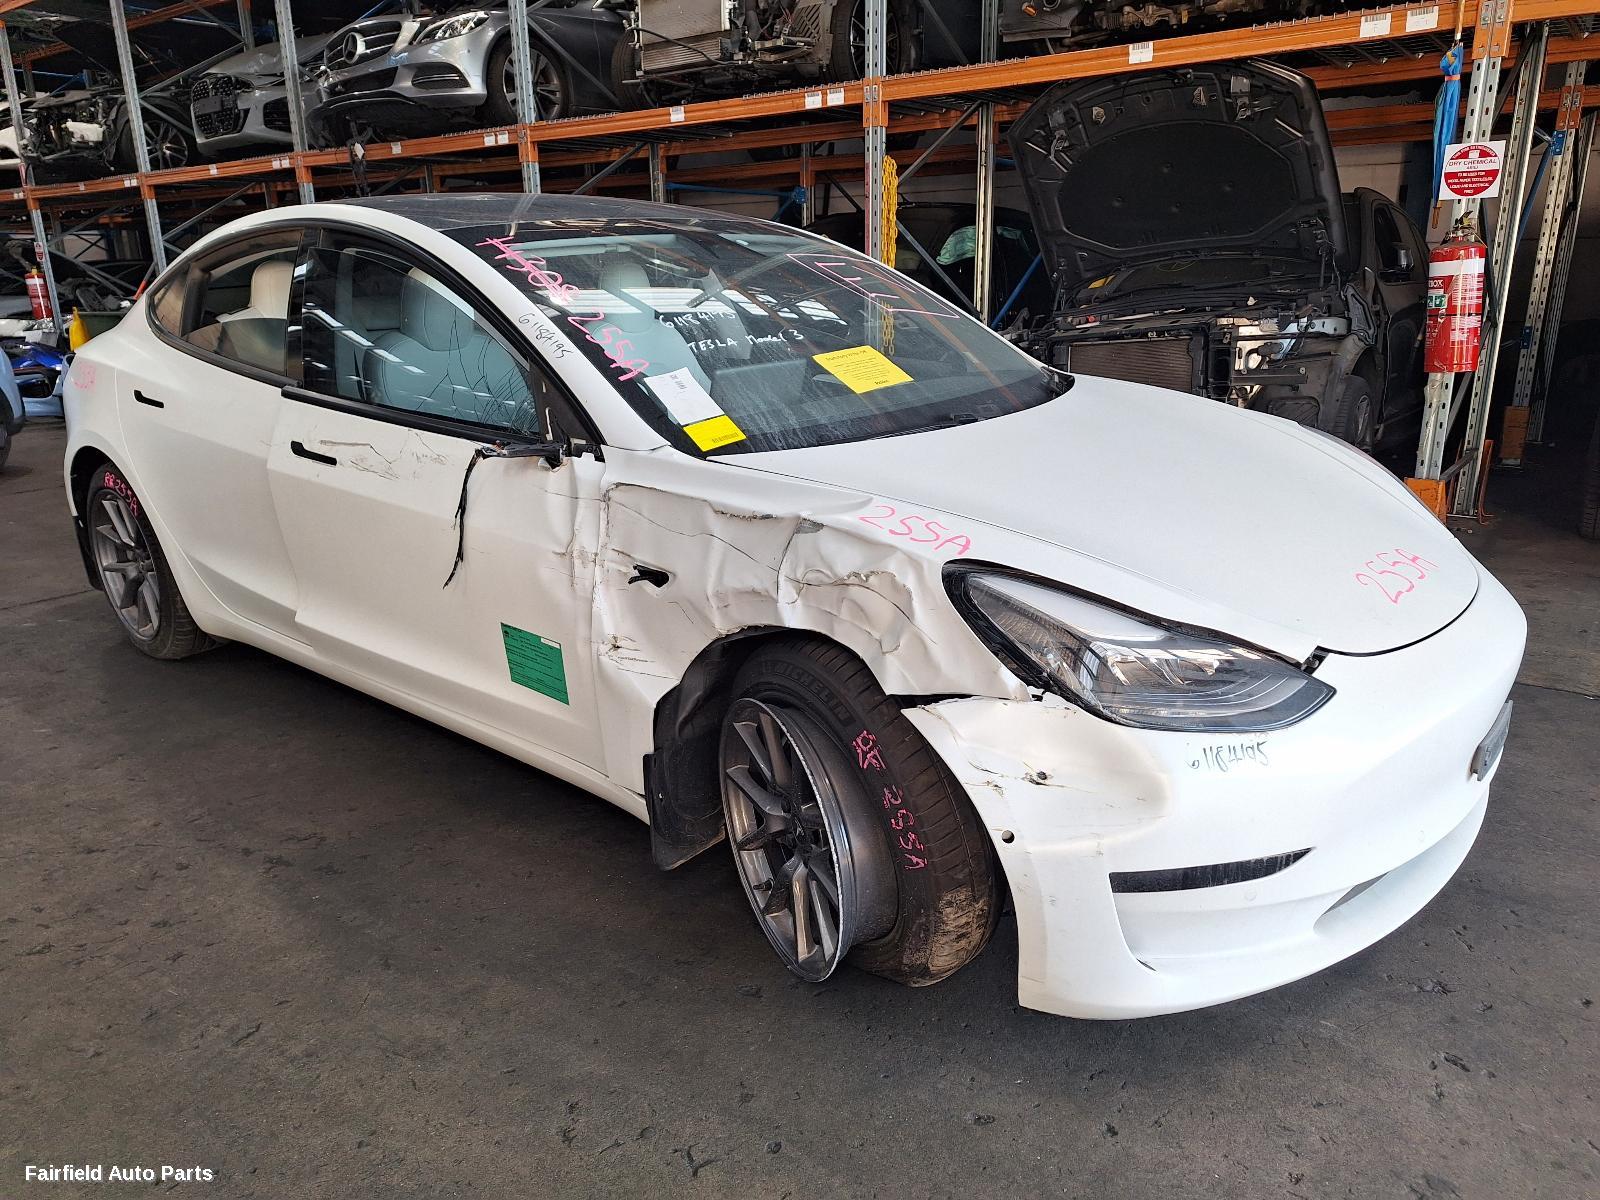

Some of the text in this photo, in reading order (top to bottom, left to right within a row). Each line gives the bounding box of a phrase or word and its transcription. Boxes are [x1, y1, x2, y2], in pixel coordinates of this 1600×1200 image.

[1463, 158, 1497, 166] CHEMICAL
[518, 312, 574, 359] 61184195
[566, 305, 650, 382] 255A
[687, 335, 739, 353] TESLA
[788, 328, 805, 341] 3
[858, 504, 972, 556] 255A
[1353, 547, 1440, 604] 255A
